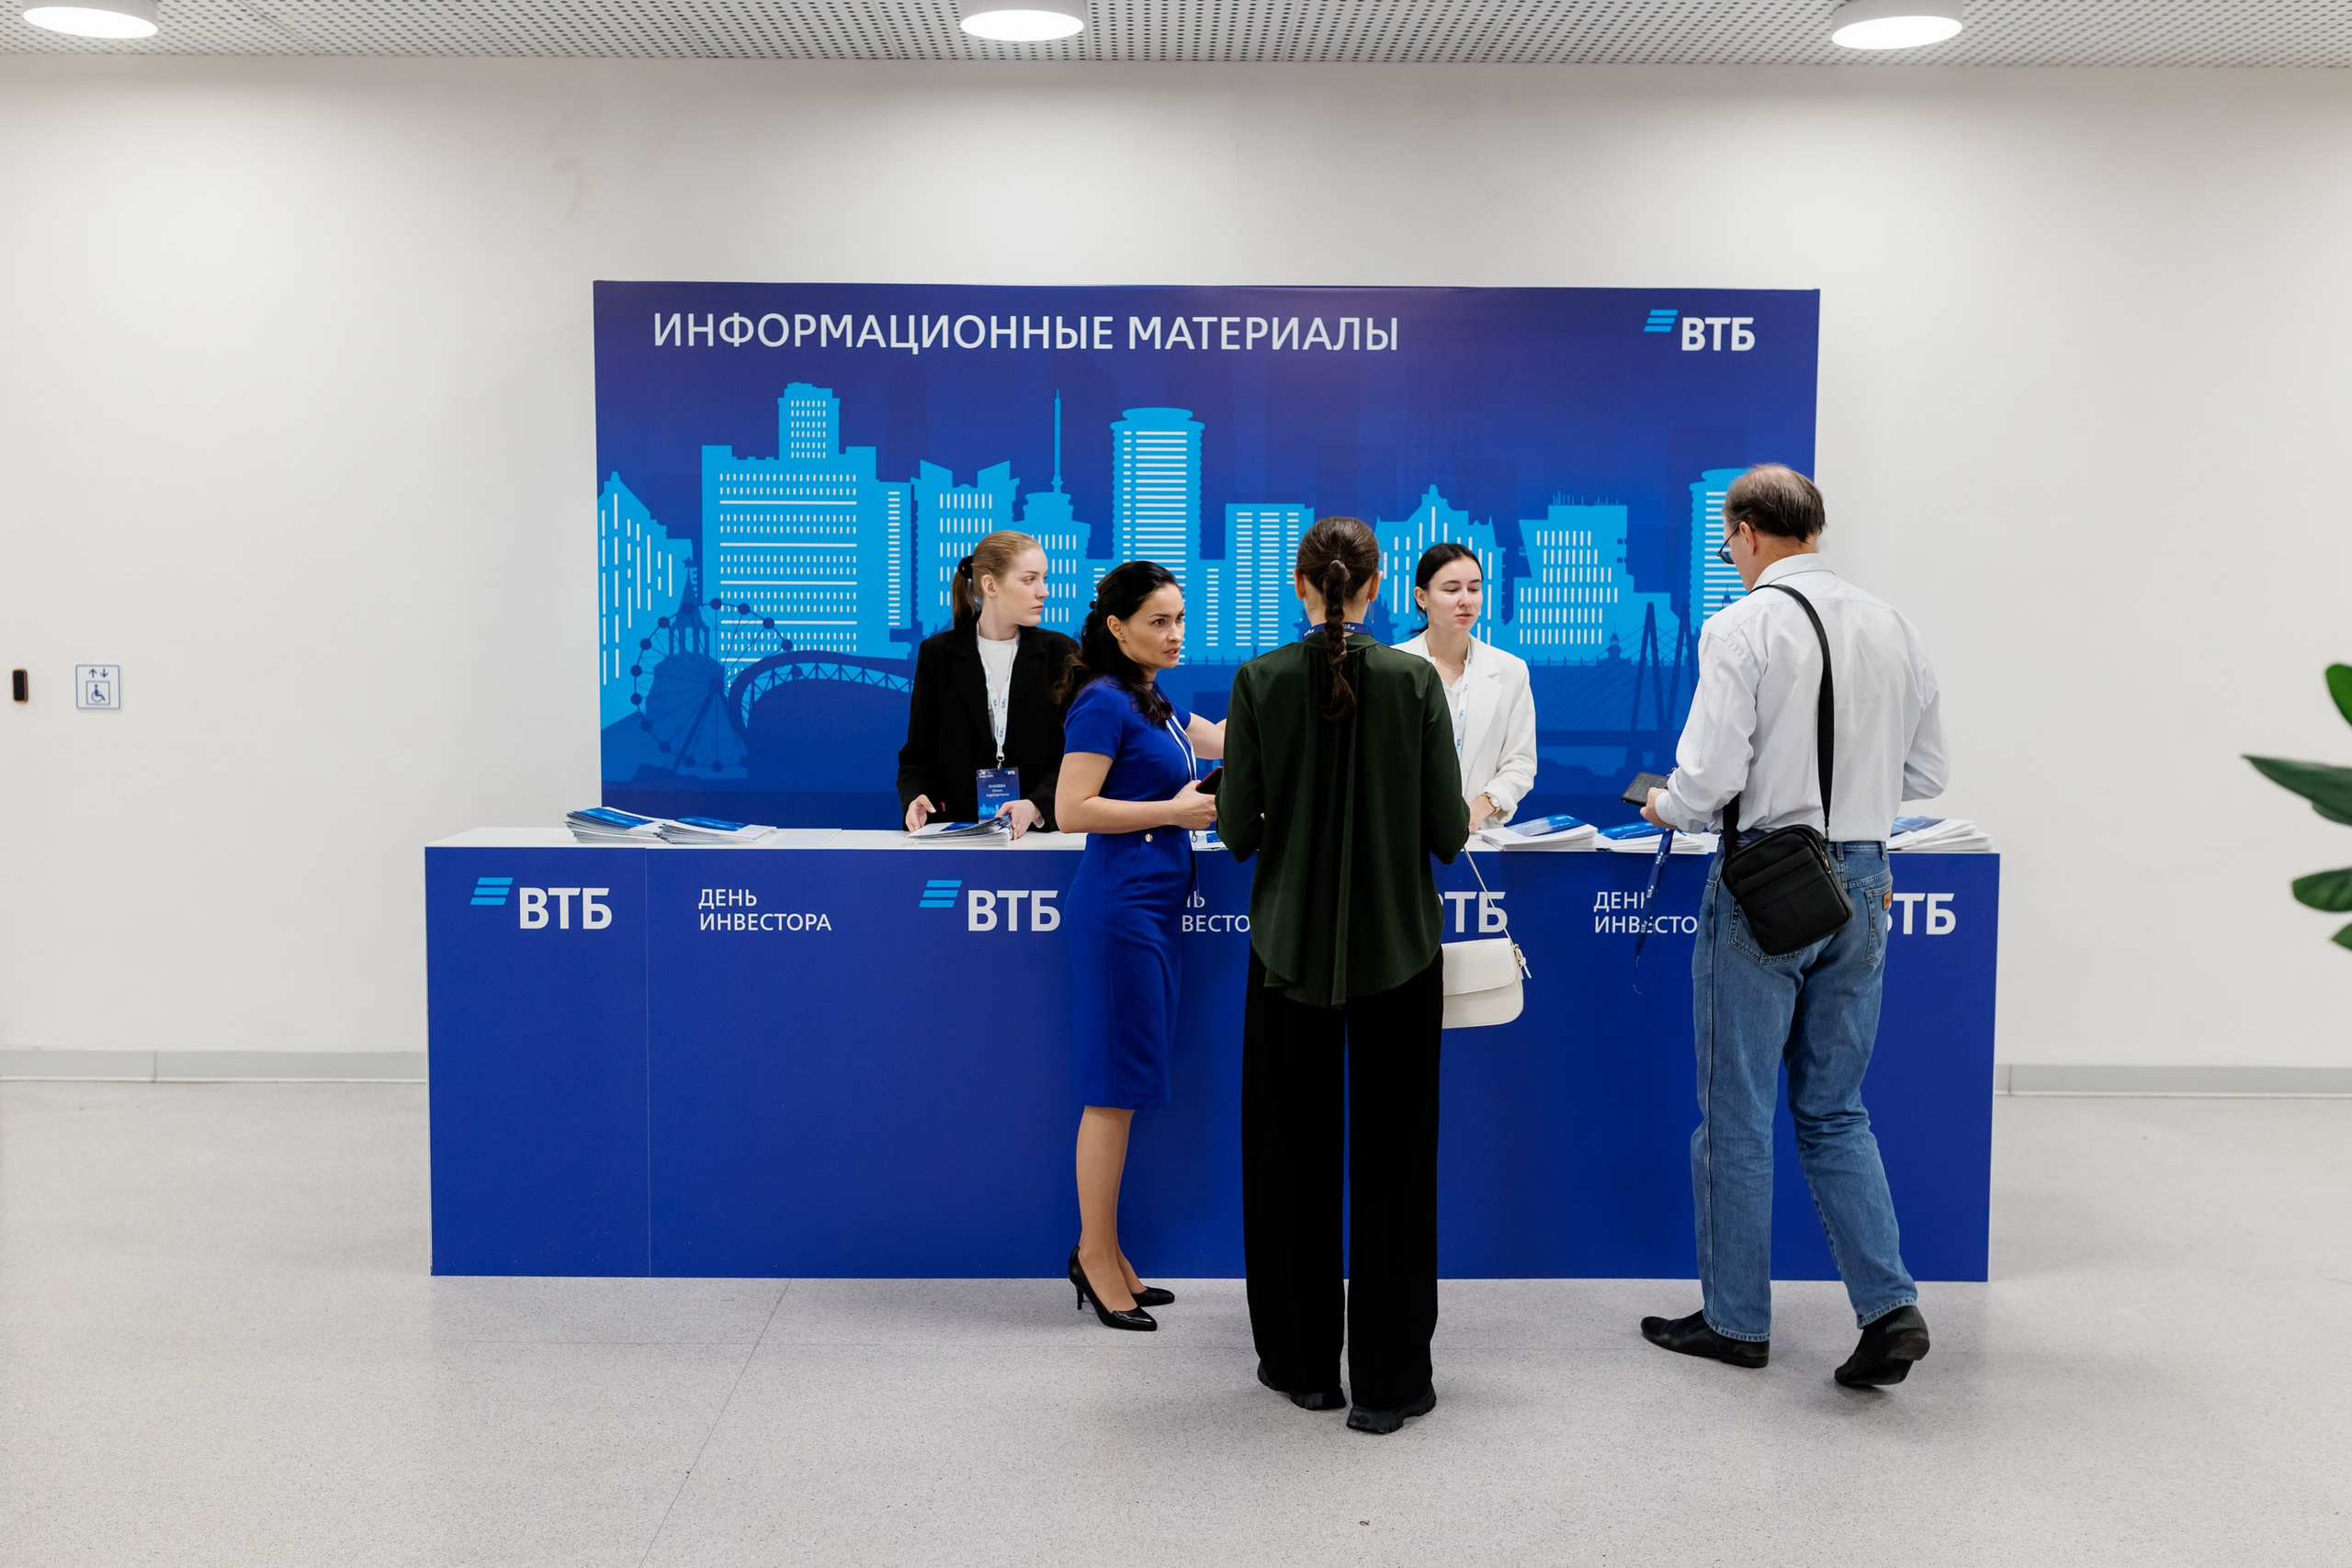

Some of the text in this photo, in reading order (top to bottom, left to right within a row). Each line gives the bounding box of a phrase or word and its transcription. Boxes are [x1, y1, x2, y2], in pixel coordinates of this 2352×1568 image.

[653, 312, 1398, 355] ИНФОРМАЦИОННЫЕ МАТЕРИАЛЫ
[1680, 316, 1756, 352] ВТБ
[519, 886, 613, 931] ВТБ
[697, 888, 758, 910] ДЕНЬ
[967, 889, 1061, 932] ВТБ
[1438, 891, 1509, 933] ТБ
[1887, 892, 1957, 935] ТБ
[698, 913, 832, 931] ИНВЕСТОРА
[1182, 914, 1250, 933] ВЕСТО
[1594, 915, 1699, 934] ИНВСТО
